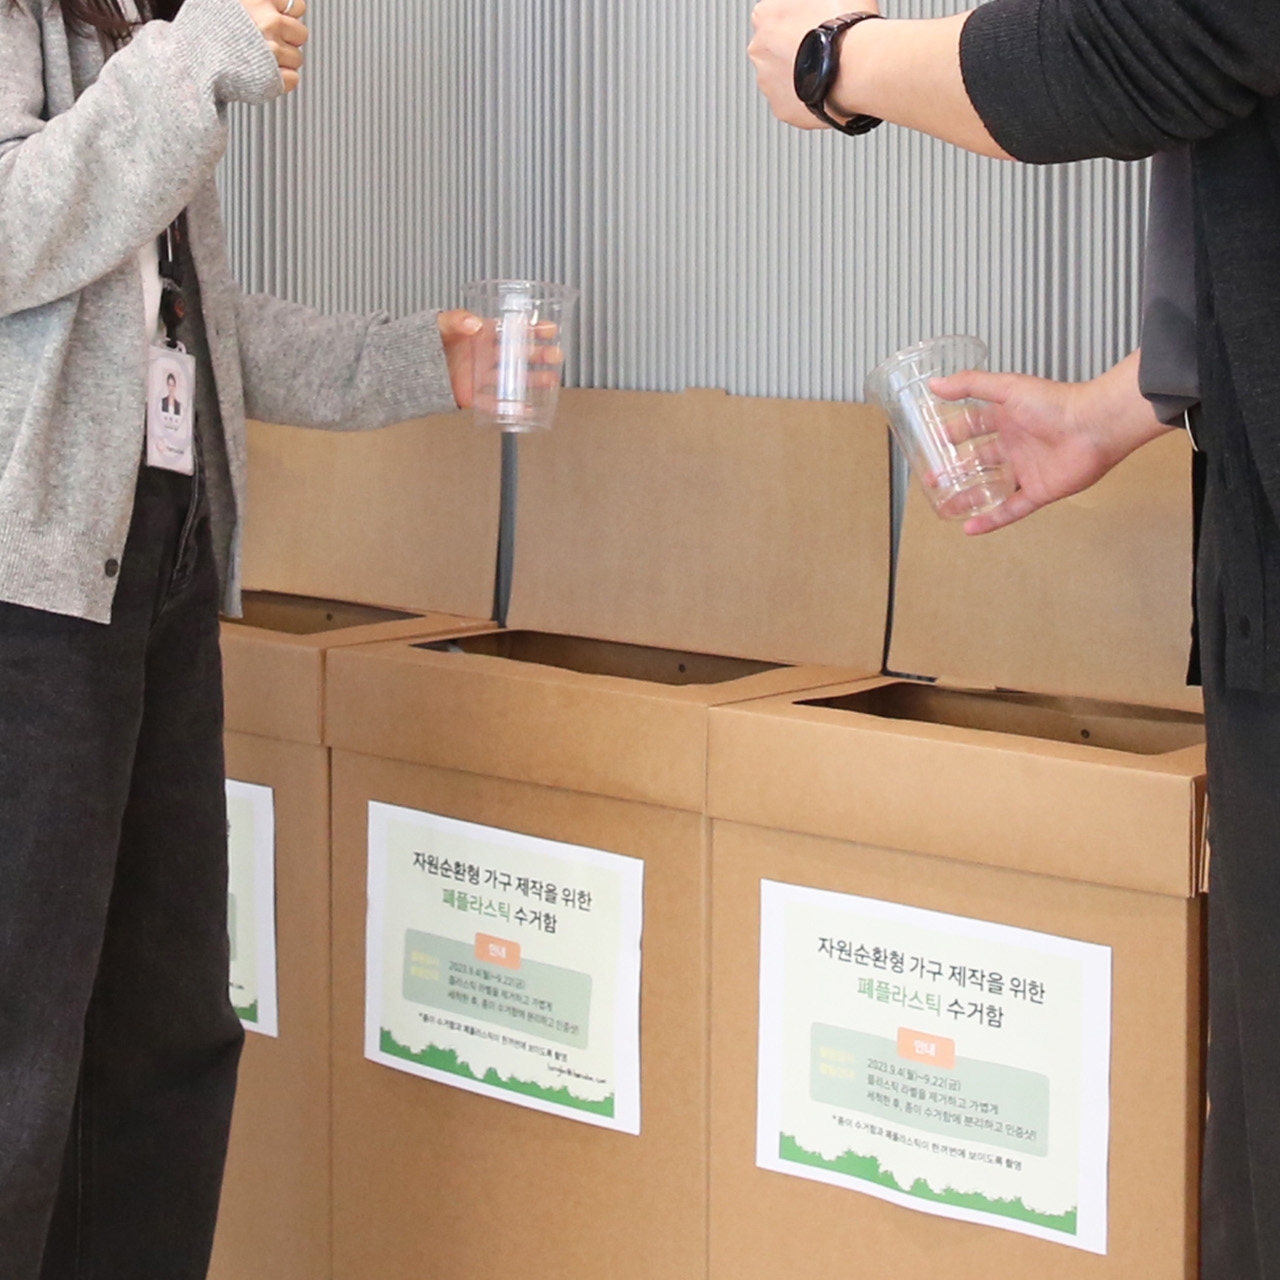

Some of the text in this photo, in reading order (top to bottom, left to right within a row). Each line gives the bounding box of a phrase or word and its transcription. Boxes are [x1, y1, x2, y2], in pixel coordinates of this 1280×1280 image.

[413, 852, 592, 912] 자원순환형 가구 제작을 위한
[443, 888, 556, 933] 폐플라스틱 수거함
[818, 937, 1046, 1005] 자원순환형 가구 제작을 위한
[857, 976, 1004, 1028] 폐플라스틱 수거함
[914, 1039, 936, 1056] 안내
